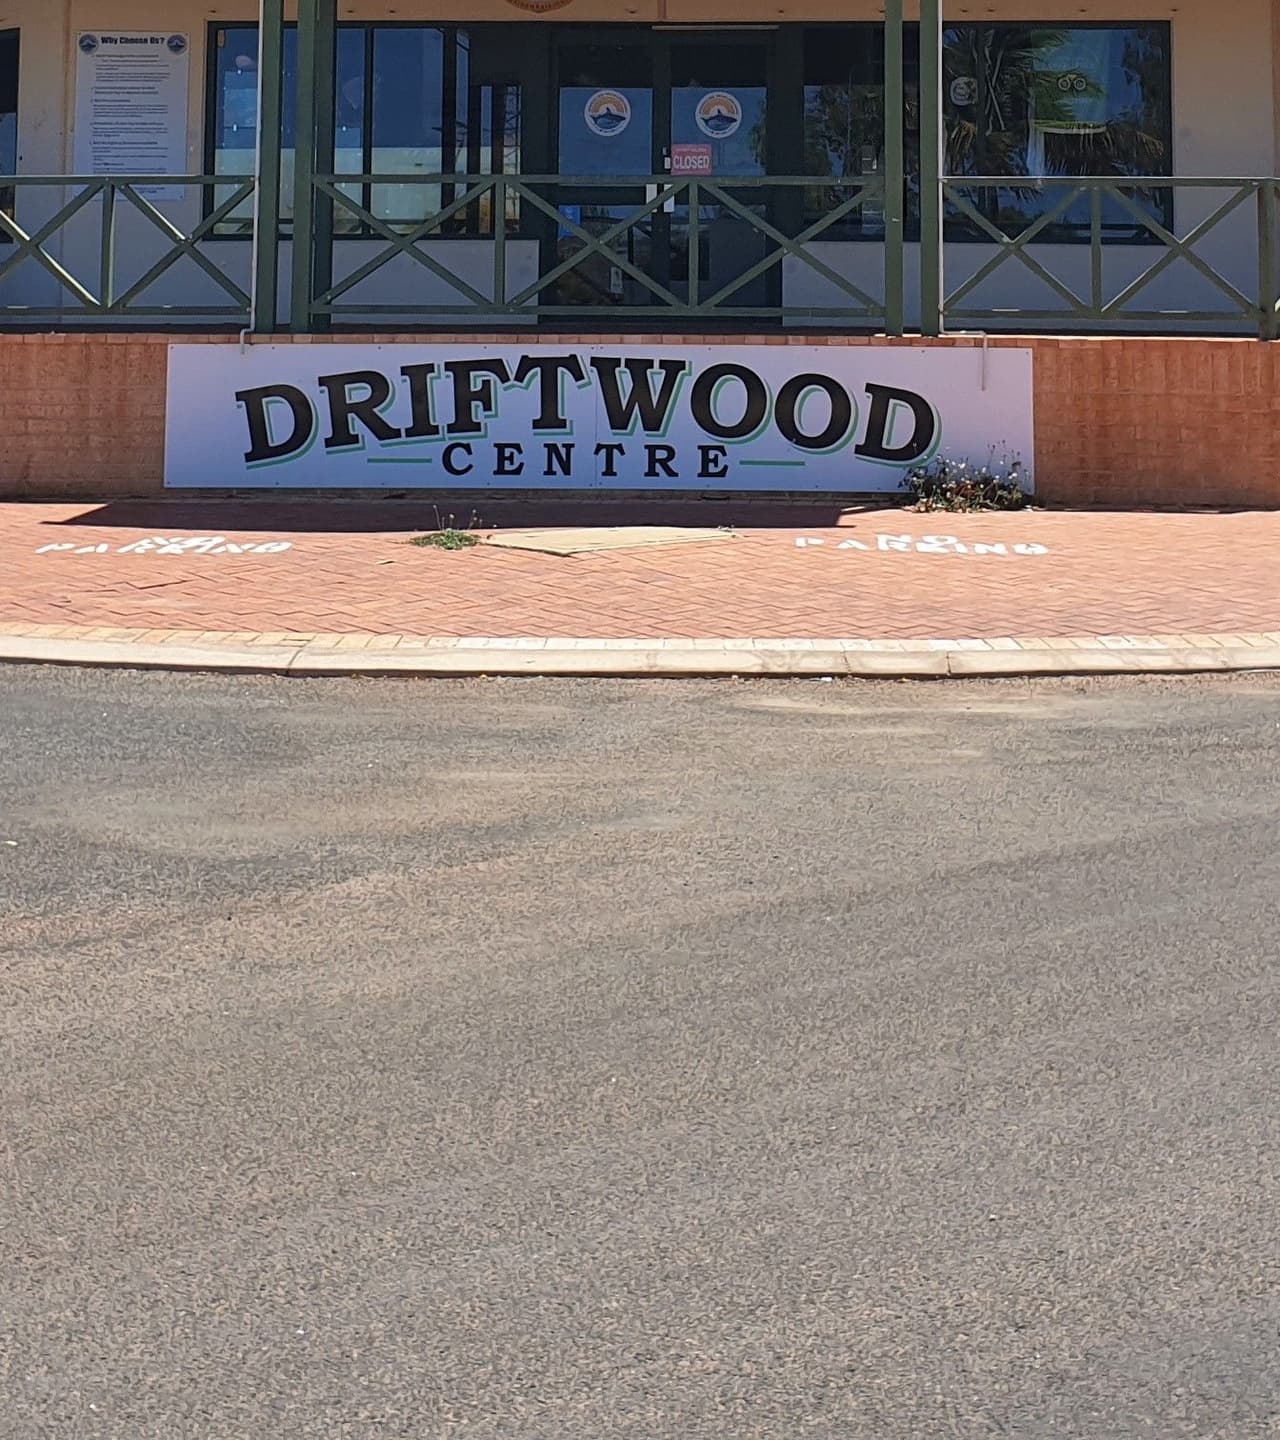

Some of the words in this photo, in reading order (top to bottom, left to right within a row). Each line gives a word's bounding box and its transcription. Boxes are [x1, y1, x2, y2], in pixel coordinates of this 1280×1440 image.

[672, 155, 710, 169] CLOSED
[234, 354, 942, 468] DRIFTWOOD
[441, 444, 729, 478] CENTRE
